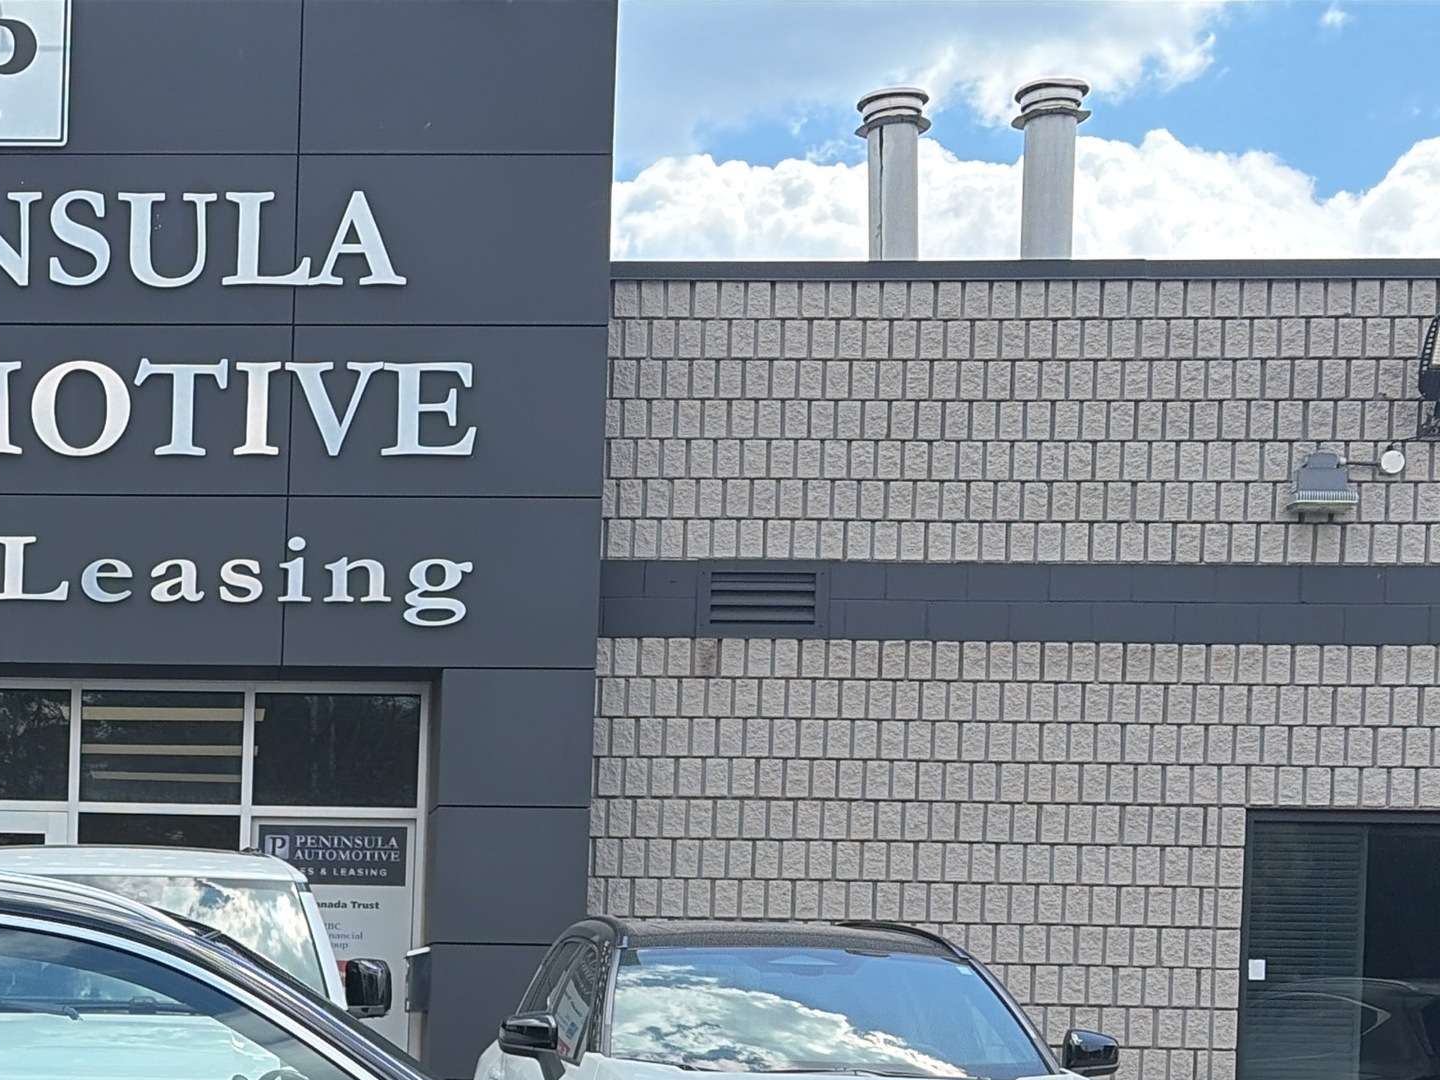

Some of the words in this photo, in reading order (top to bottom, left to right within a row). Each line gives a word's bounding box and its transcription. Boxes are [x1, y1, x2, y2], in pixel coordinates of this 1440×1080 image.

[295, 834, 399, 849] PENINSULA
[293, 849, 401, 862] AUTOMOTIVE
[332, 867, 388, 877] LEASING
[350, 901, 380, 910] Trust
